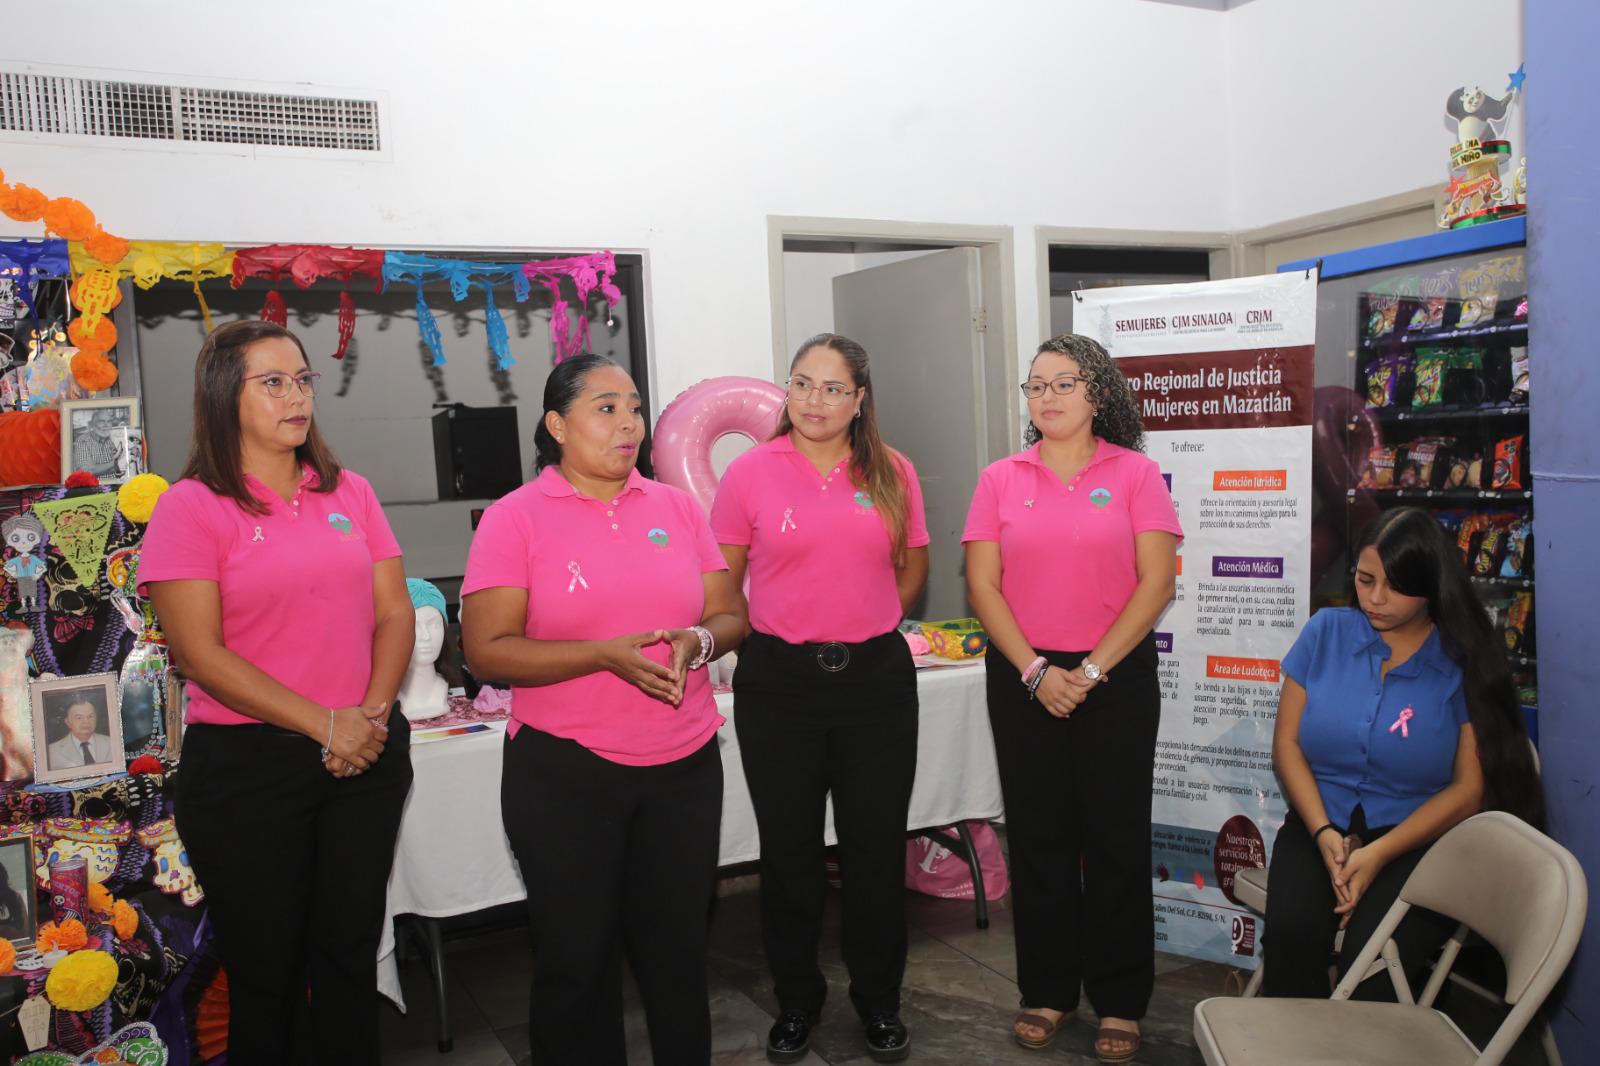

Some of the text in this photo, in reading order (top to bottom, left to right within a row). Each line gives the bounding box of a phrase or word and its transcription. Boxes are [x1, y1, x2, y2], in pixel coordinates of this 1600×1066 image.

[1461, 151, 1481, 164] NIÑO
[1116, 316, 1167, 333] SEMUJERES
[1172, 315, 1190, 329] CJM
[1192, 312, 1233, 327] SINALOA
[1143, 368, 1205, 396] Regional
[1207, 367, 1224, 388] de
[1226, 364, 1281, 389] Justicia
[1143, 392, 1292, 422] Mujeres en Mazatlán
[1171, 442, 1180, 452] Te
[1220, 477, 1253, 487] Atención
[1200, 498, 1218, 507] Ofrece
[1225, 498, 1257, 507] orientación
[1284, 498, 1297, 508] legal
[1200, 509, 1214, 518] sobre
[1292, 509, 1297, 517] la
[1200, 520, 1228, 530] protección
[1228, 520, 1236, 528] de
[1218, 561, 1279, 574] Atención Médica
[1276, 584, 1295, 594] médica
[1198, 594, 1204, 602] de
[1206, 594, 1224, 604] primer
[1218, 616, 1233, 625] salud
[1238, 618, 1252, 628] para
[1231, 663, 1241, 675] de
[1242, 666, 1276, 678] Ludoteca
[1226, 833, 1256, 846] Nuestros
[1218, 848, 1262, 862] servicios son
